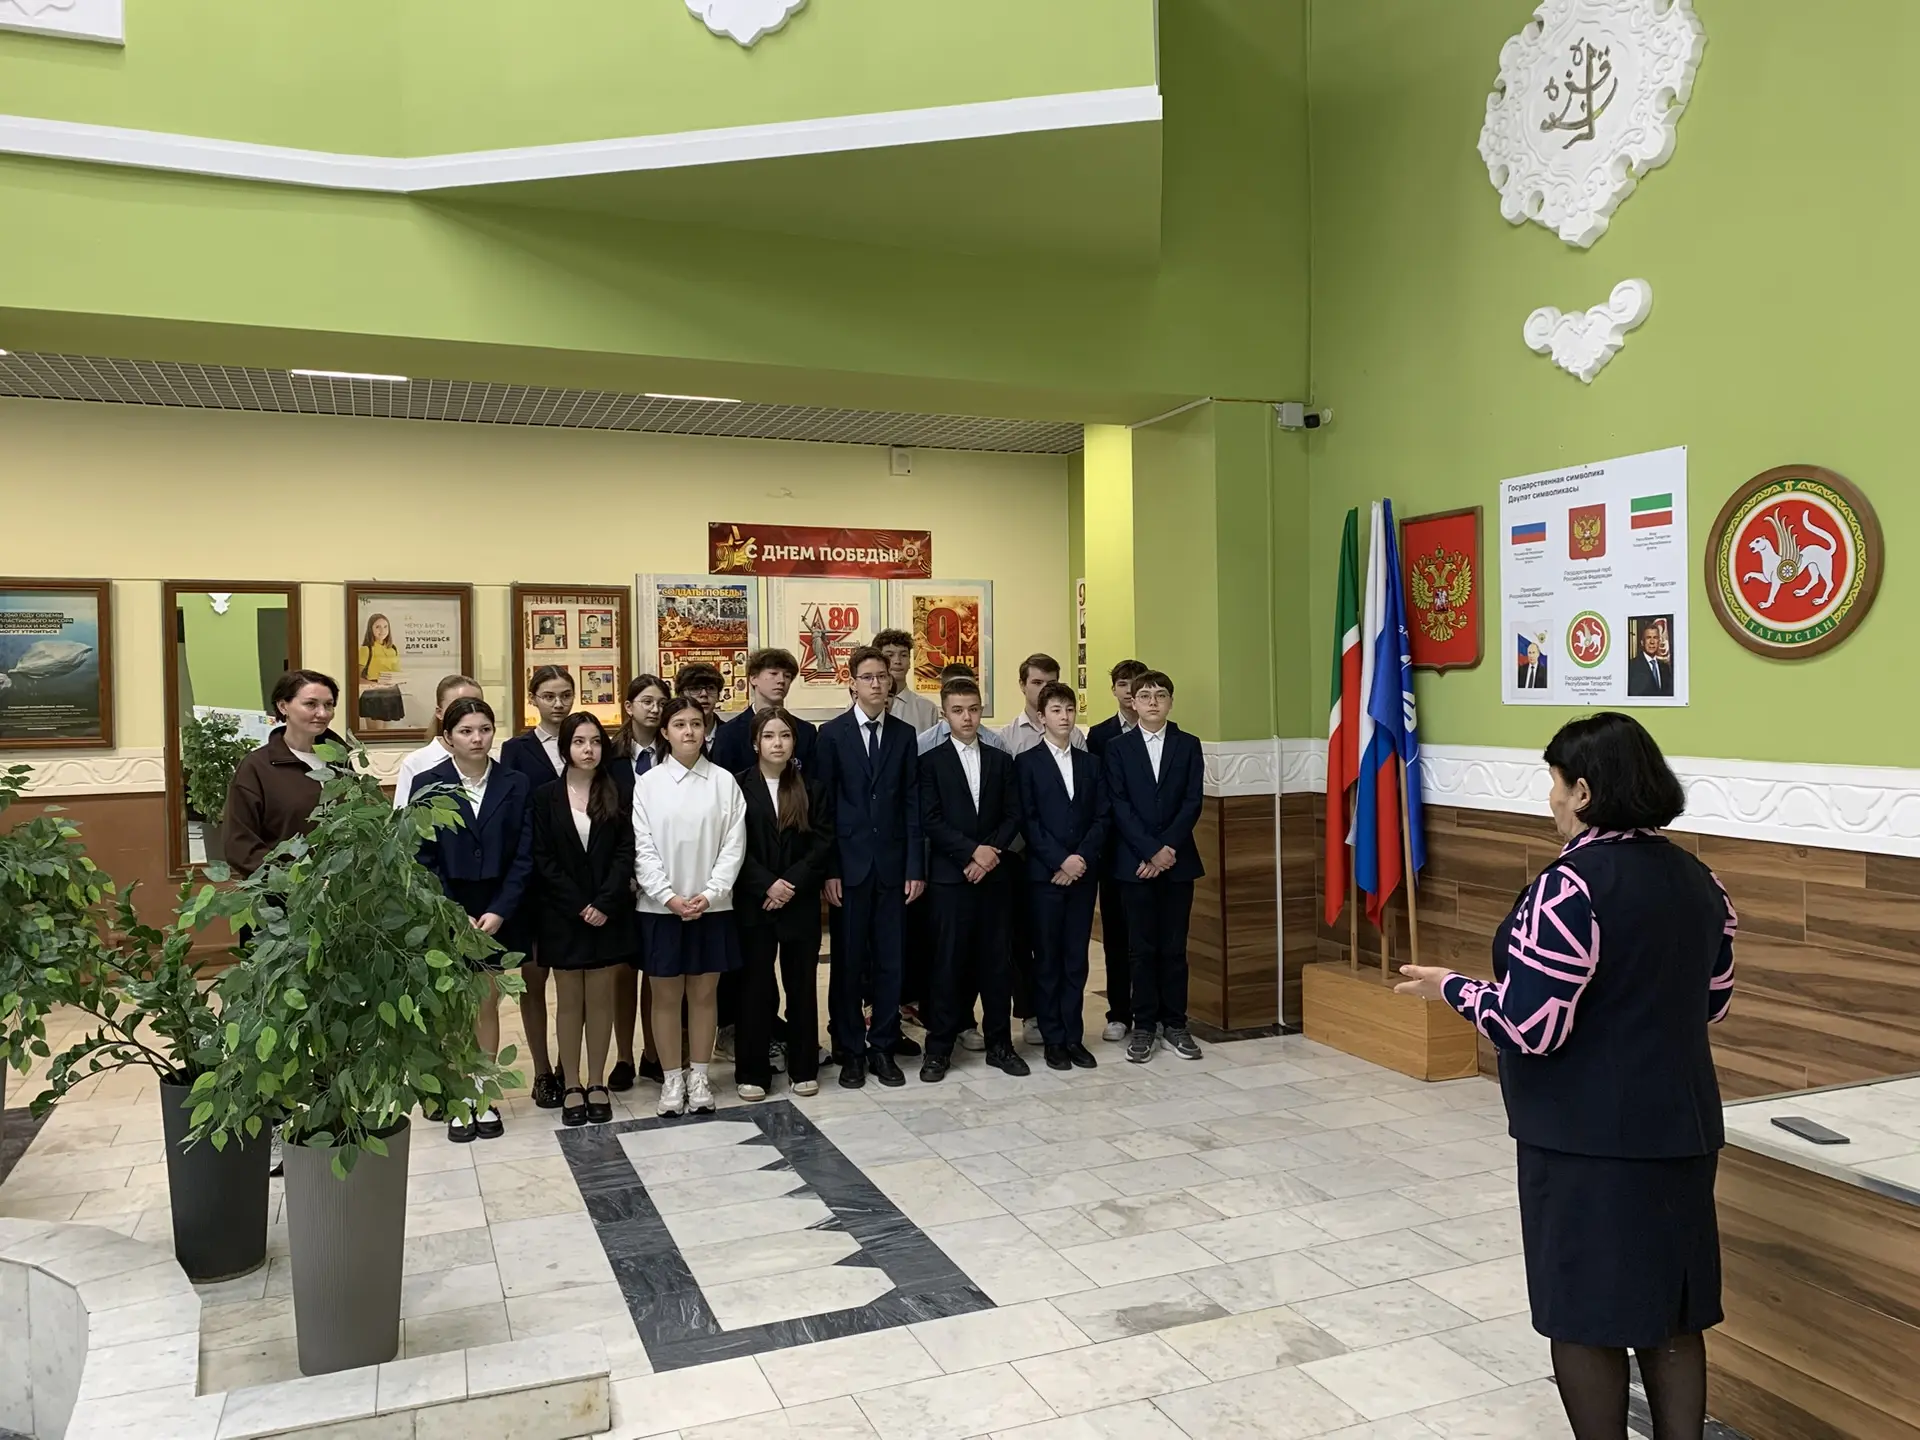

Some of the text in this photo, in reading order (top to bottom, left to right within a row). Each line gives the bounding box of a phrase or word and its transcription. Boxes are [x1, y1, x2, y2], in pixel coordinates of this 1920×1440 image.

[1508, 469, 1604, 492] Государственная символика
[1532, 486, 1579, 499] символикасы
[745, 545, 899, 564] С ДНЕМ ПОБЕДЫ!
[662, 588, 703, 597] СОЛДАТЫ
[828, 607, 859, 631] 80
[926, 607, 960, 667] 9
[1748, 619, 1833, 642] ТАТАРСТАН
[943, 655, 974, 668] МАЯ
